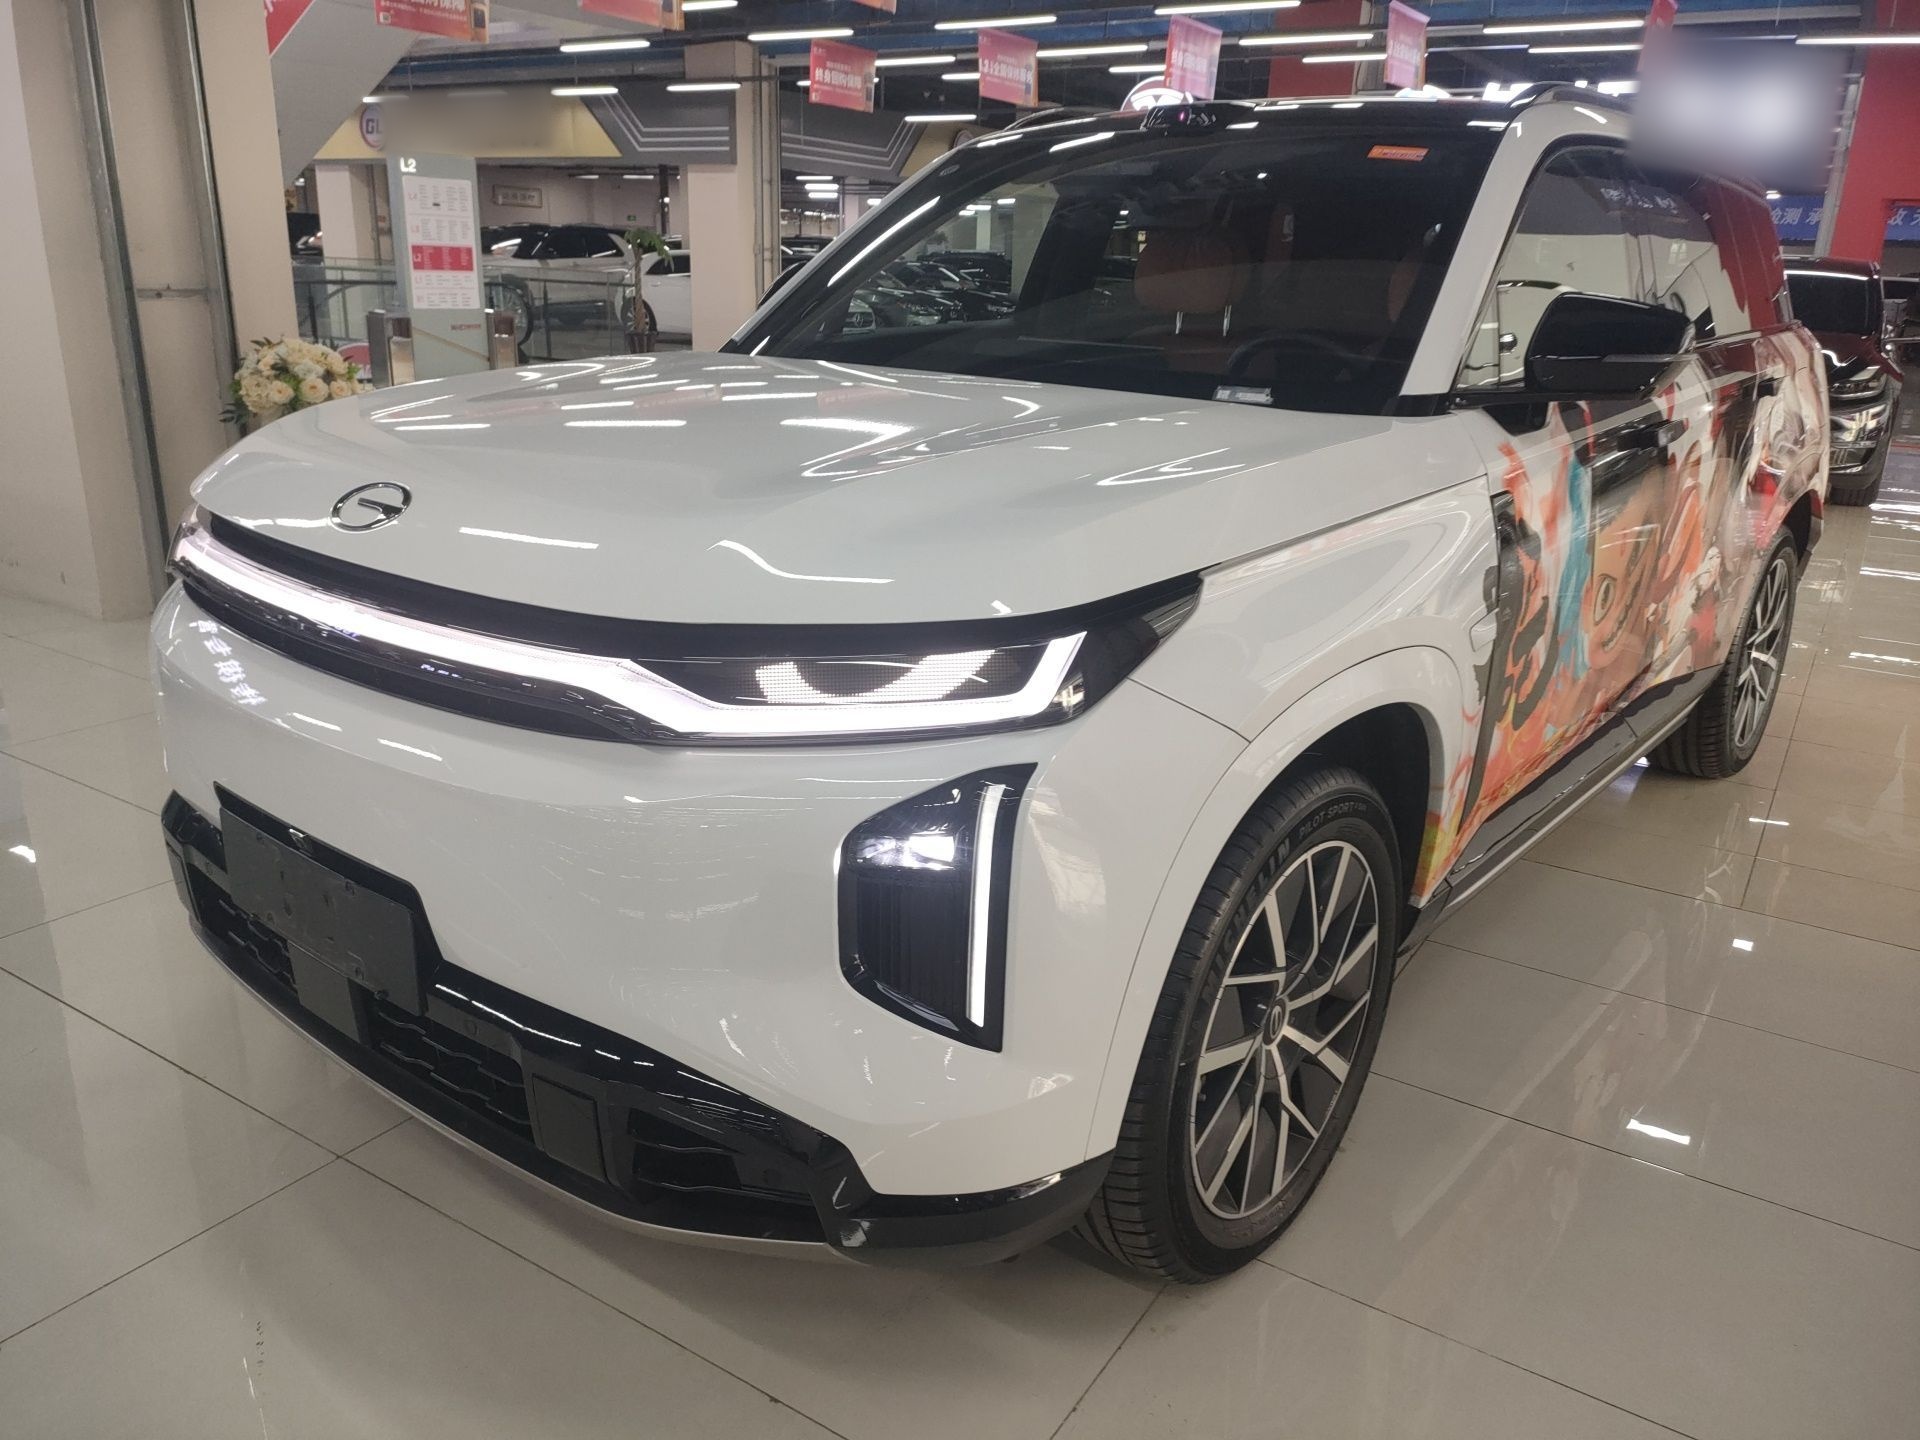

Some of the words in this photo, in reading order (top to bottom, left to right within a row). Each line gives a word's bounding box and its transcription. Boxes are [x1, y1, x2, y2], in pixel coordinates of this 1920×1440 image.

[400, 157, 416, 173] L2
[1299, 811, 1326, 839] PILOT
[1327, 801, 1355, 819] SPORT
